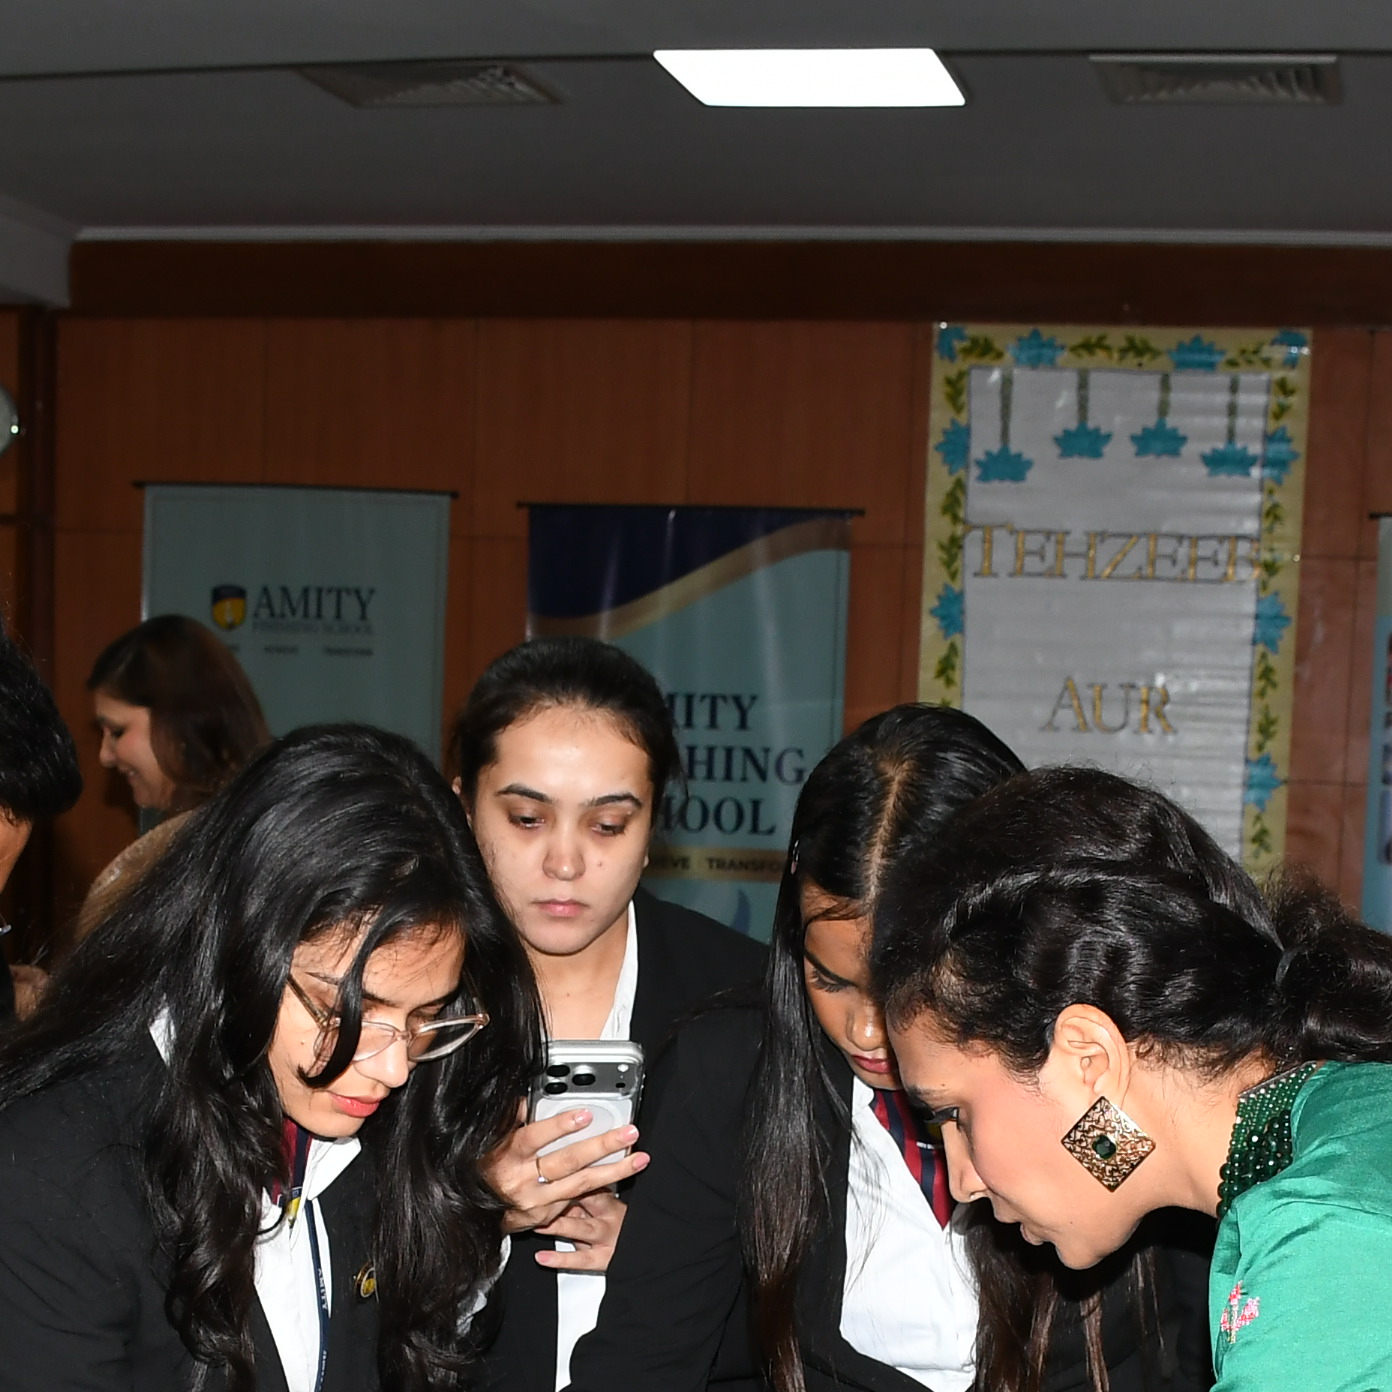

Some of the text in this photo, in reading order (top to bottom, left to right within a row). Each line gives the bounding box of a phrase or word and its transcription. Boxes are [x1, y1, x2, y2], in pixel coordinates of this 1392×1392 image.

[962, 523, 1260, 584] TEHZEEB
[253, 585, 376, 621] AMITY
[1039, 675, 1178, 734] AUR
